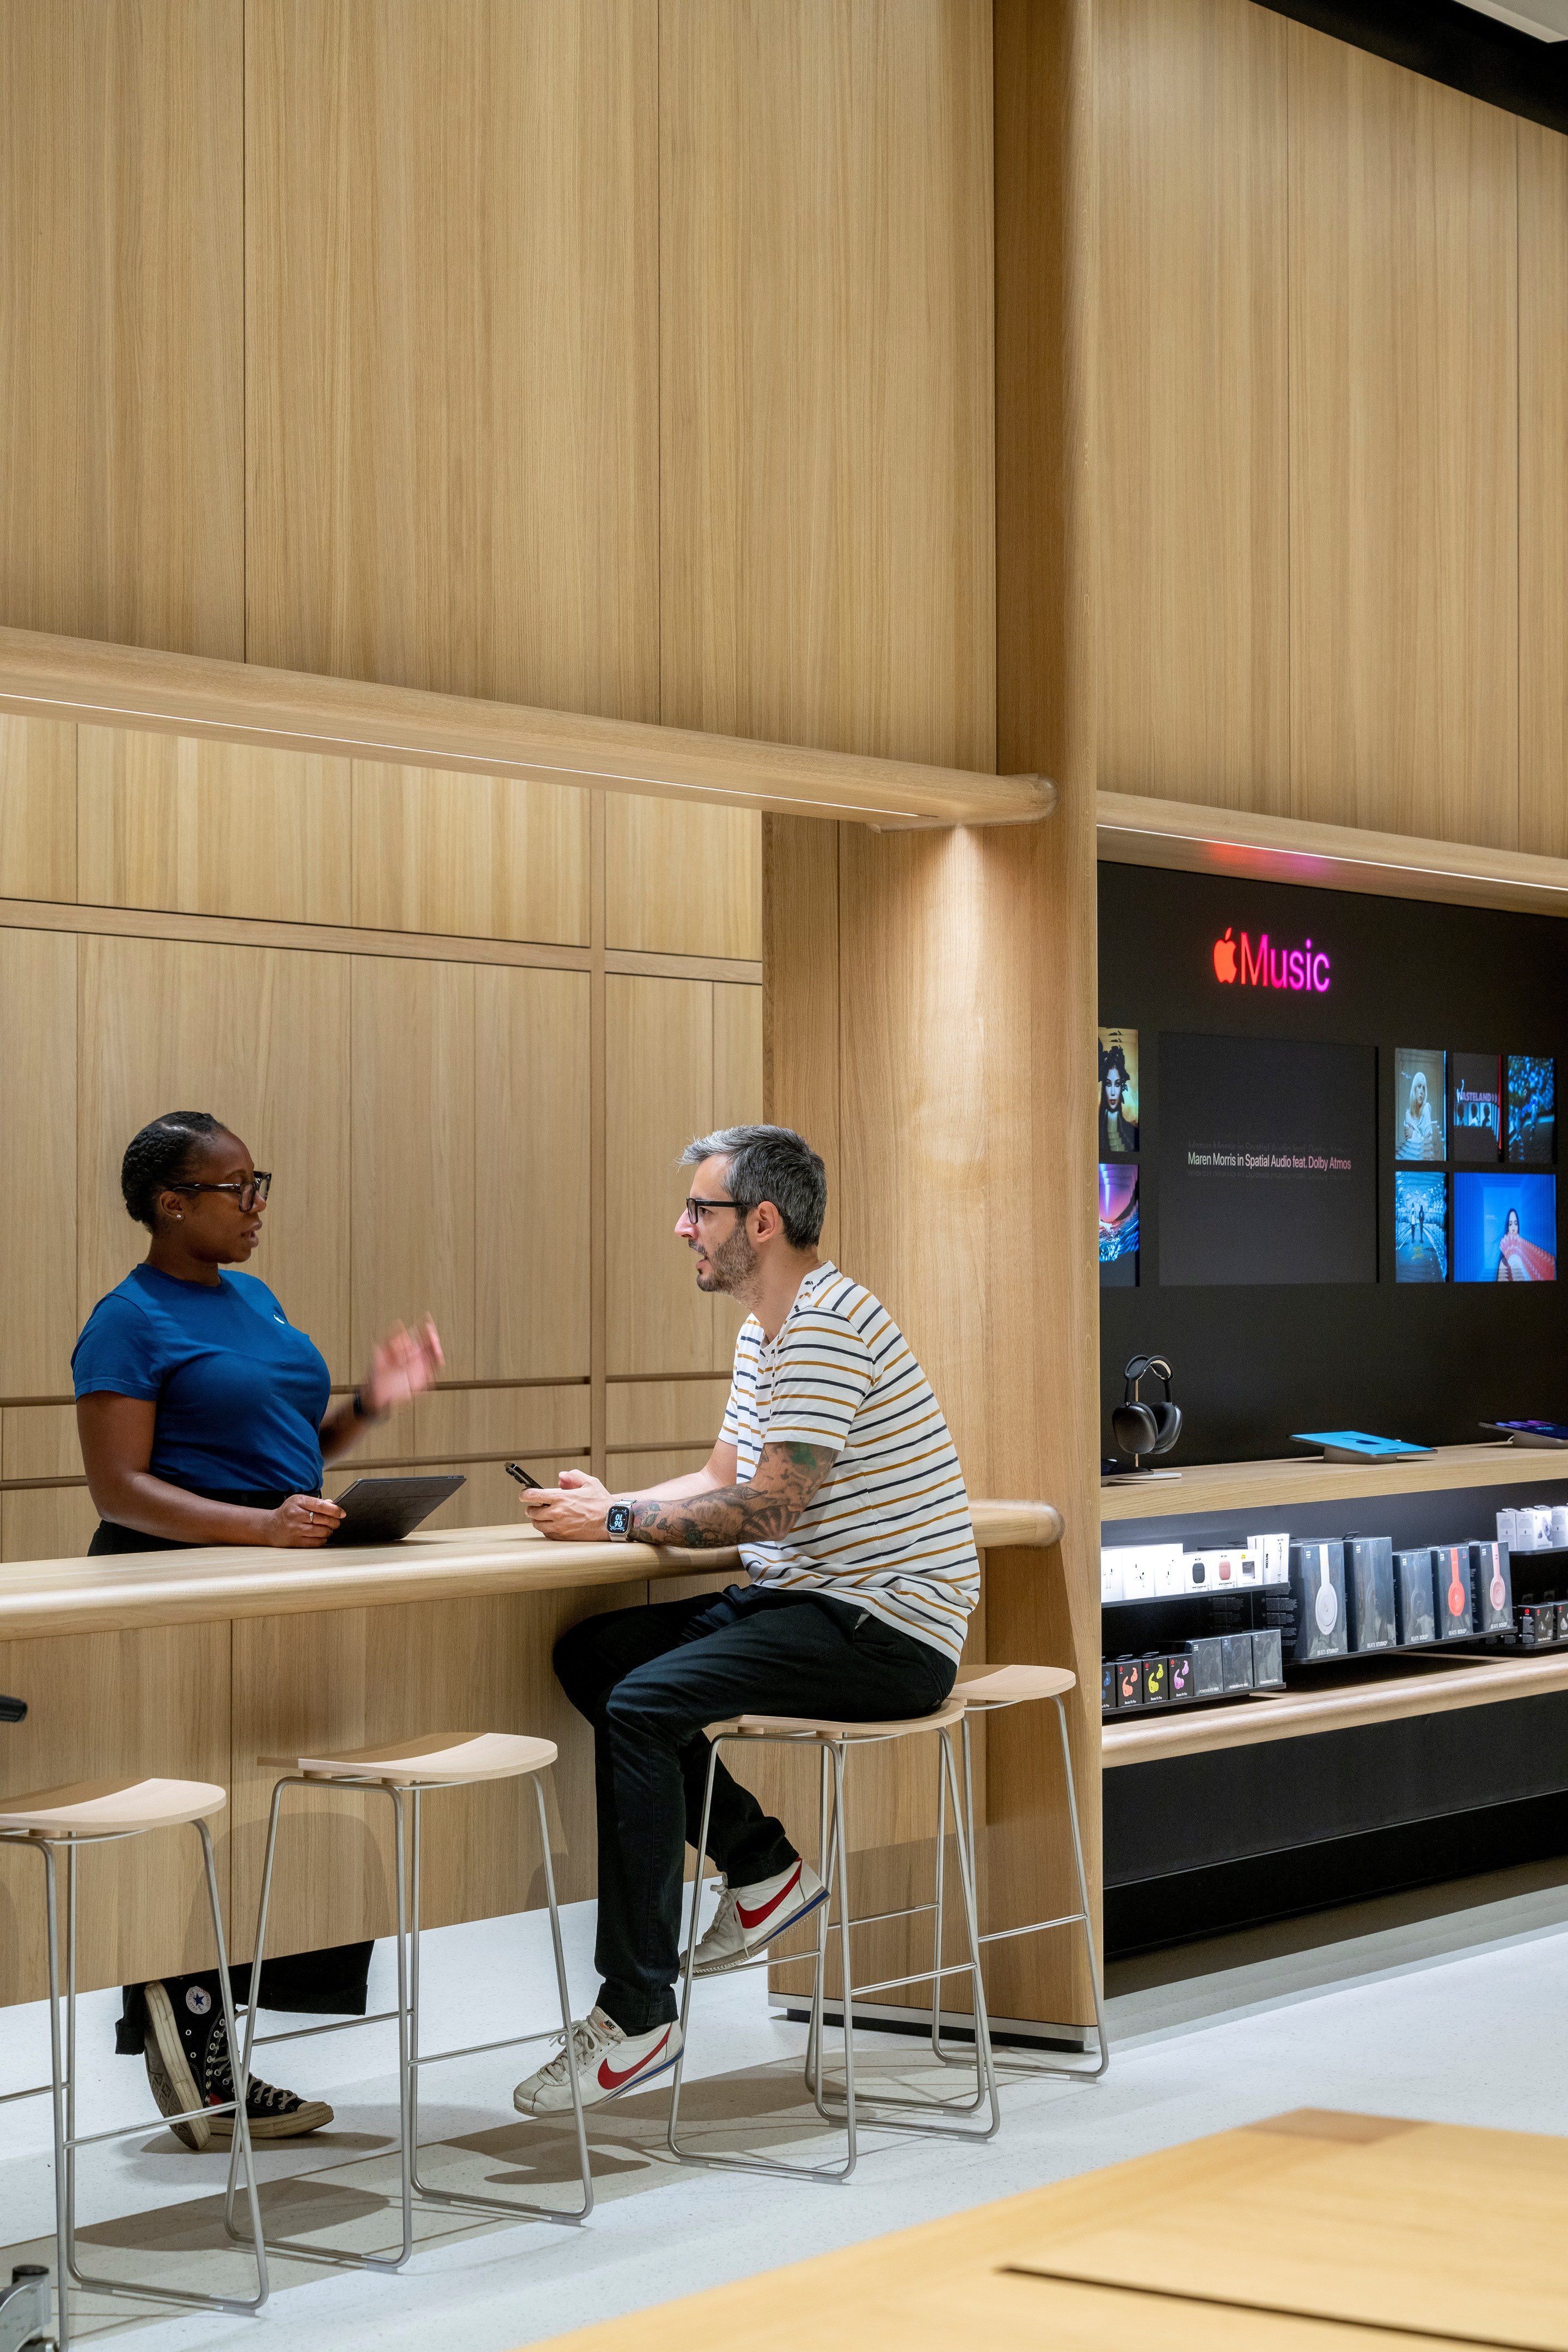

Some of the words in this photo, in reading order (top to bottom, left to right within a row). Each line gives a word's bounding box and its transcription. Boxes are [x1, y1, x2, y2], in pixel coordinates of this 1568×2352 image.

[1240, 932, 1330, 992] Music
[1456, 1079, 1492, 1103] WASTELAND
[1188, 1152, 1211, 1165] Maren
[1212, 1153, 1236, 1166] Morris
[1237, 1153, 1244, 1166] in
[1245, 1153, 1270, 1169] Spatial
[1271, 1154, 1291, 1168] Audio
[1293, 1155, 1308, 1168] feat.
[1308, 1155, 1328, 1171] Dolby
[1329, 1156, 1351, 1169] Atmos
[189, 2001, 198, 2011] STAR
[196, 1988, 210, 2007] CONVERSE
[604, 2019, 616, 2030] NIKE
